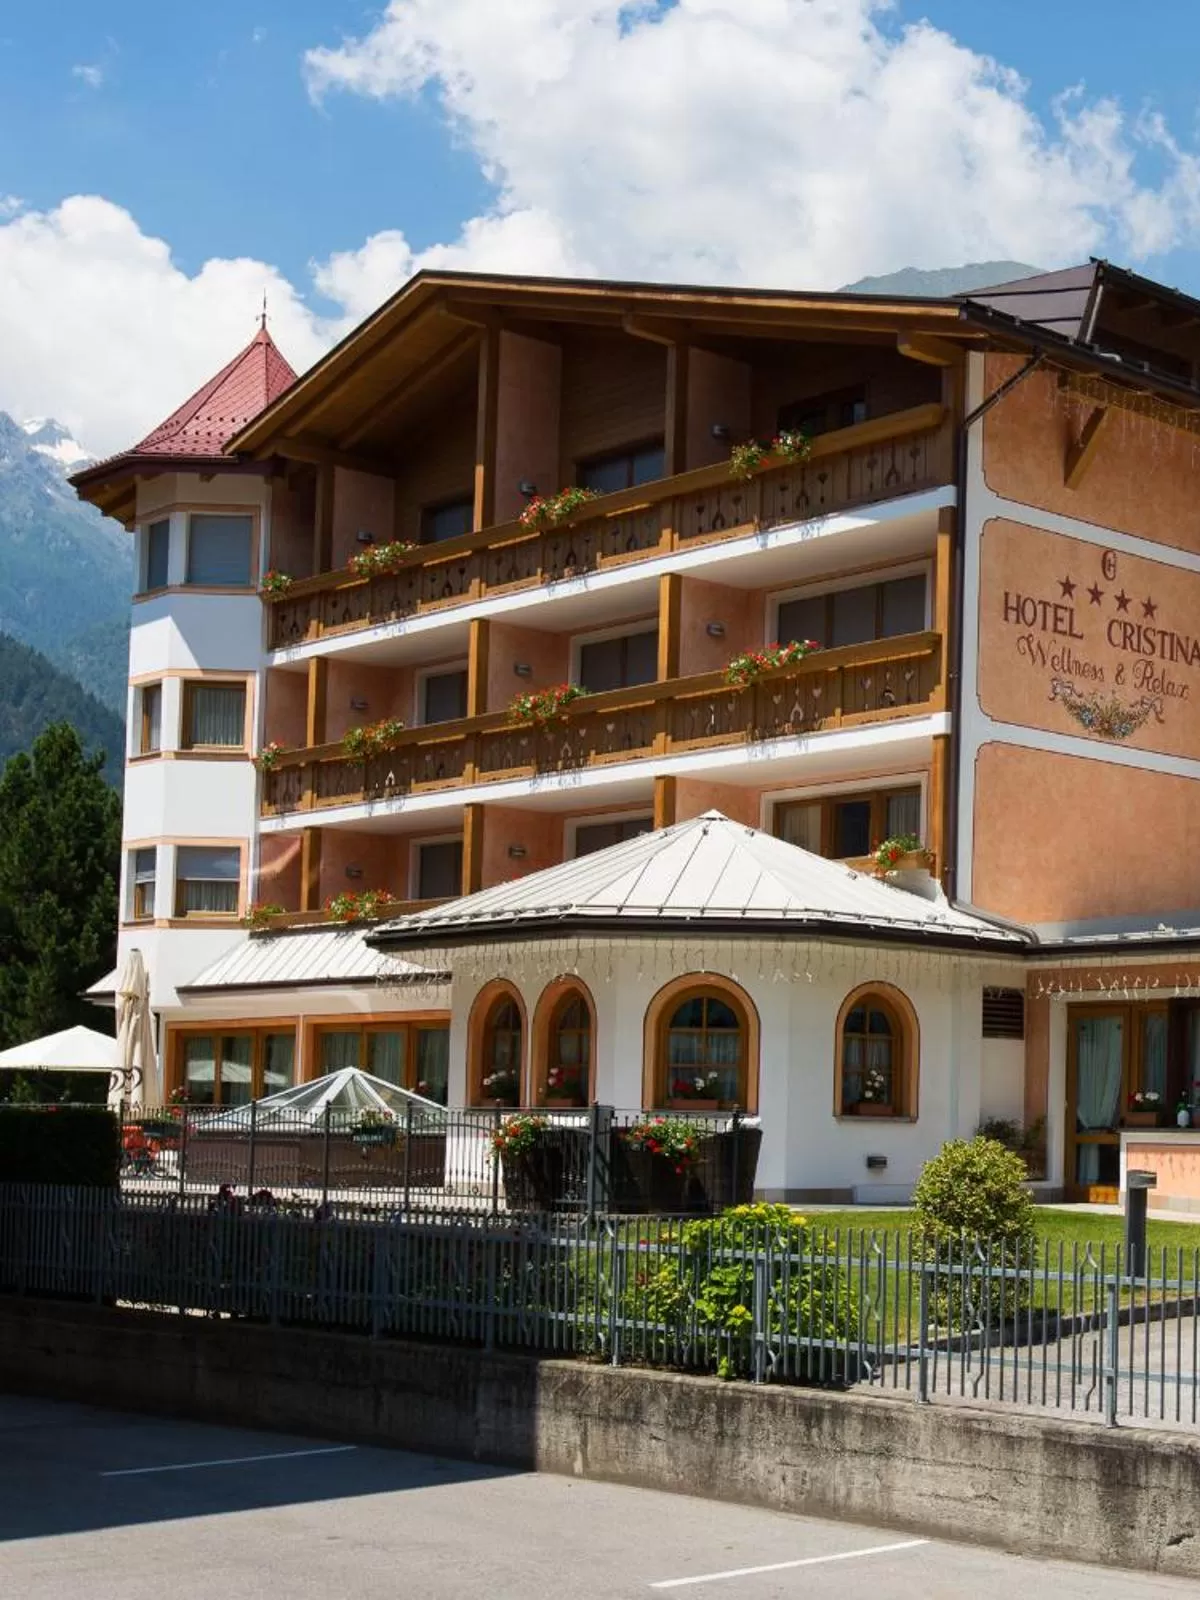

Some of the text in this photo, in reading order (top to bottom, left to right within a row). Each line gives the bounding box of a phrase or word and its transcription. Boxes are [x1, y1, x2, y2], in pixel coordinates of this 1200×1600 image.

[1003, 592, 1084, 640] HOTEL
[1017, 634, 1189, 700] Wellness & Relax
